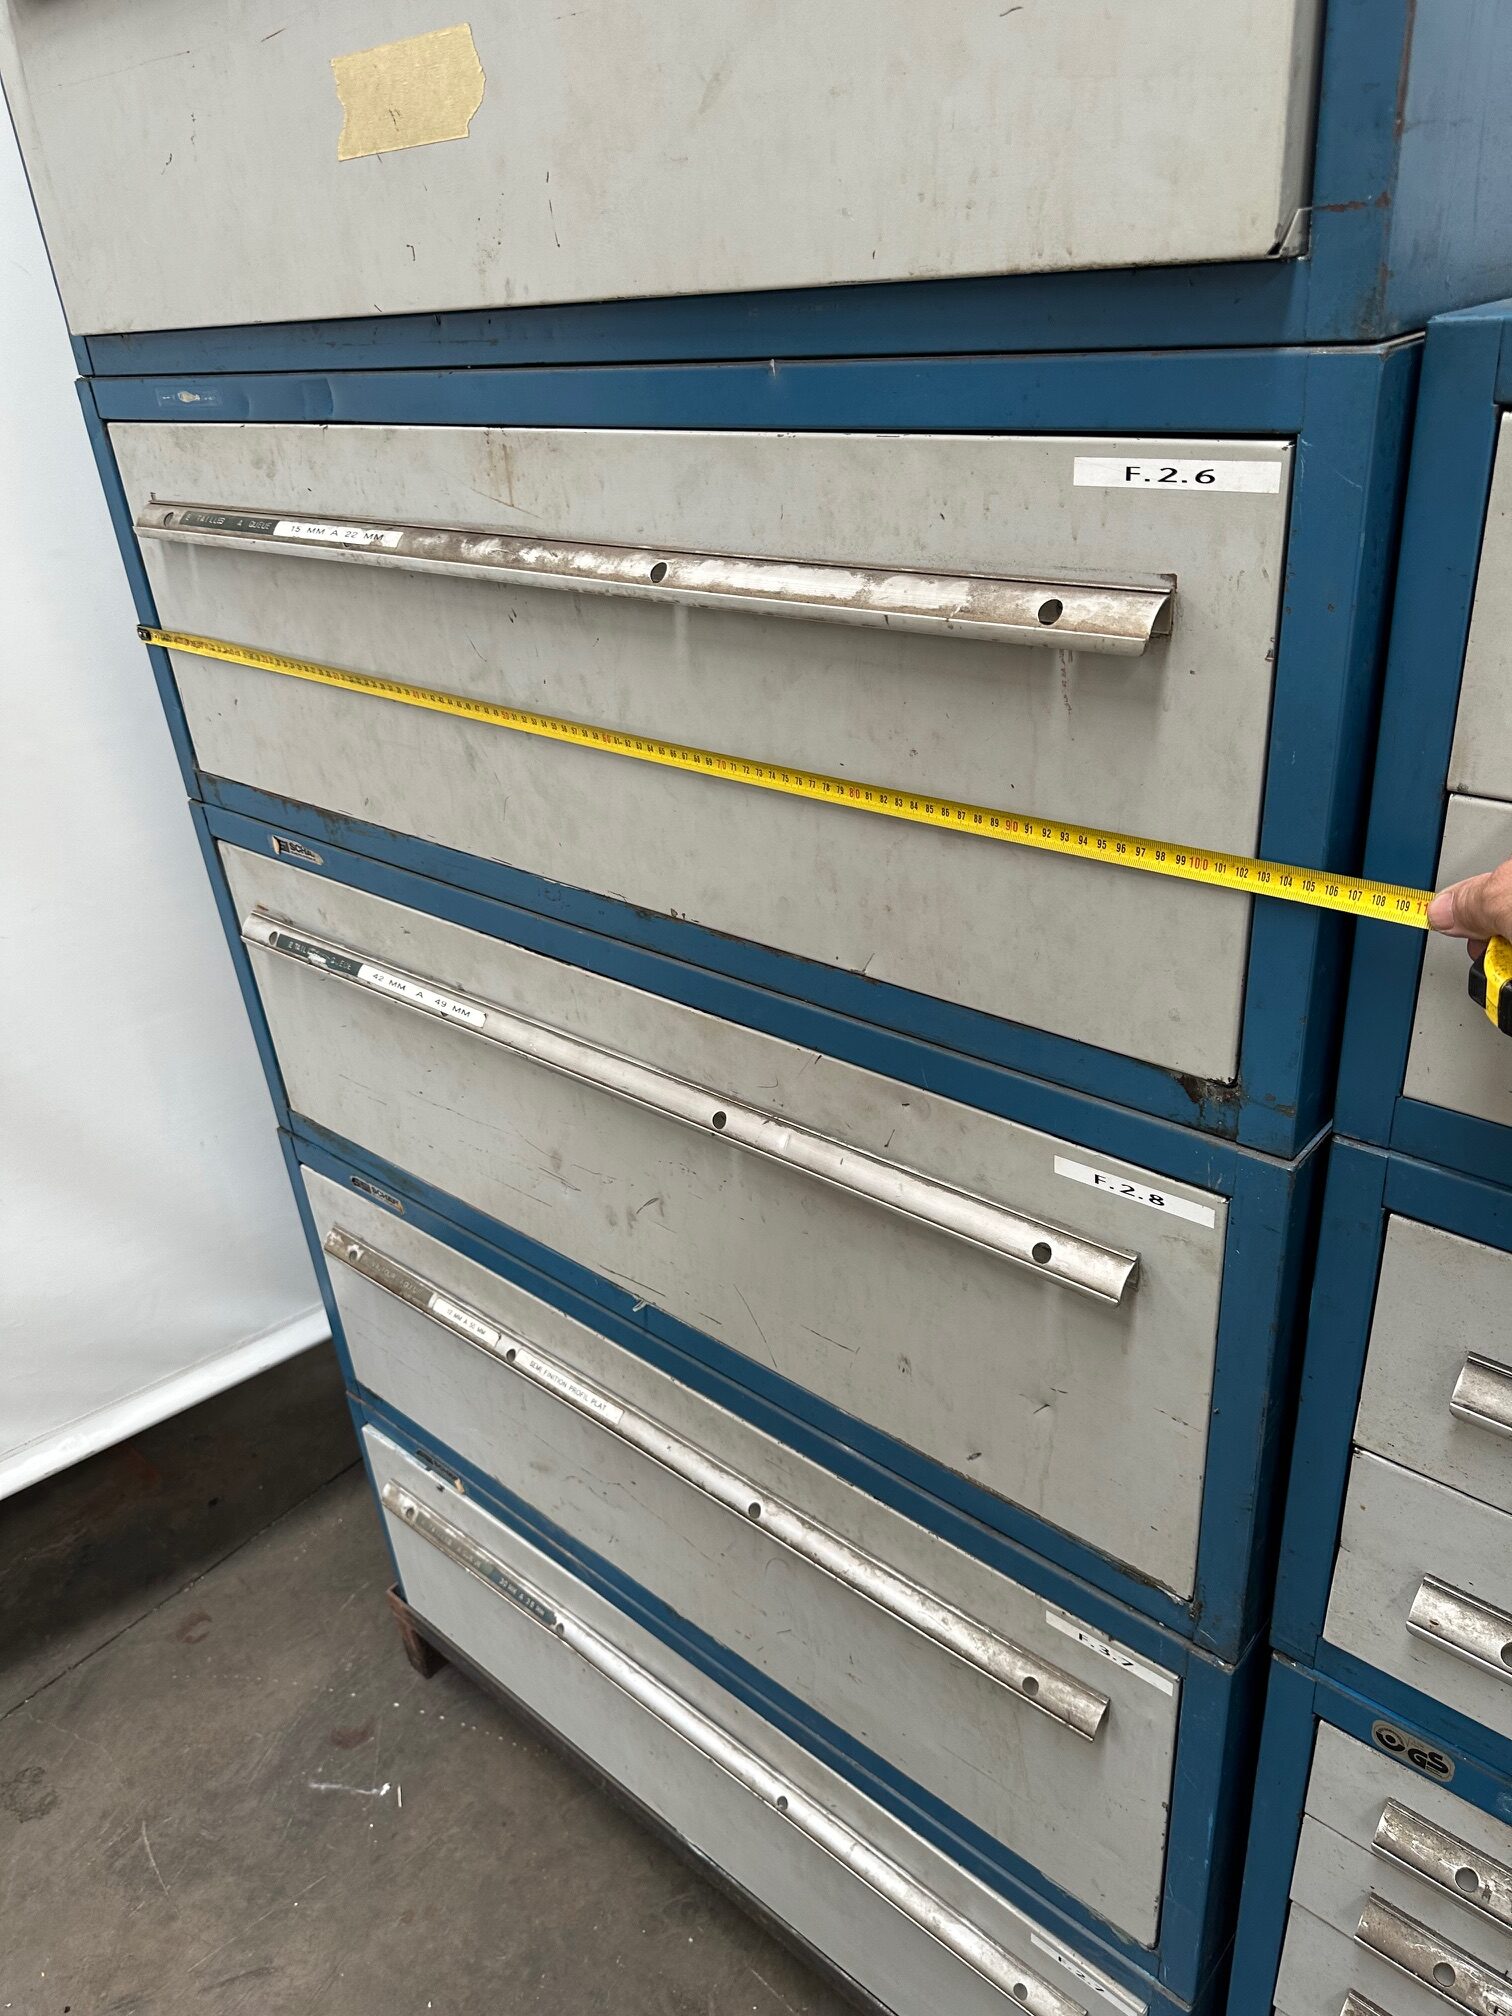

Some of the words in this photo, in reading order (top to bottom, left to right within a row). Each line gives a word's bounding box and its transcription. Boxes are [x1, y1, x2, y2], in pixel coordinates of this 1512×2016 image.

[1125, 466, 1216, 484] F.2.6
[306, 527, 326, 535] MM
[344, 530, 358, 538] 22
[602, 733, 611, 743] 60
[614, 736, 620, 745] 61
[624, 740, 631, 748] 62
[636, 741, 642, 750] 63
[647, 744, 654, 753] 64
[658, 746, 665, 755] 65
[670, 749, 677, 758] 66
[682, 752, 688, 761] 67
[693, 754, 700, 764] 68
[705, 757, 712, 766] 69
[717, 759, 726, 770] 70
[730, 763, 737, 771] 71
[742, 765, 750, 775] 72
[756, 768, 762, 778] 73
[768, 770, 776, 780] 74
[781, 773, 789, 783] 75
[795, 776, 802, 786] 76
[808, 780, 816, 789] 77
[822, 782, 830, 792] 78
[836, 785, 844, 795] 79
[849, 787, 860, 799] 80
[865, 791, 872, 801] 81
[880, 794, 888, 805] 82
[894, 798, 903, 808] 83
[910, 800, 918, 811] 84
[925, 804, 934, 814] 85
[941, 807, 950, 817] 86
[957, 810, 966, 820] 87
[974, 814, 982, 824] 88
[990, 817, 999, 828] 89
[1005, 820, 1018, 833] 90
[1024, 823, 1033, 835] 91
[1042, 828, 1051, 839] 92
[1060, 831, 1070, 842] 93
[1078, 835, 1088, 846] 94
[1097, 839, 1107, 850] 95
[1116, 843, 1126, 854] 96
[1135, 846, 1146, 857] 97
[1155, 850, 1166, 861] 98
[1176, 854, 1186, 866] 99
[1189, 856, 1209, 871] 100
[1214, 862, 1226, 874] 101
[1236, 867, 1248, 879] 102
[1257, 871, 1271, 883] 103
[1280, 875, 1293, 888] 104
[1302, 880, 1316, 892] 105
[1325, 884, 1338, 897] 106
[1348, 889, 1363, 901] 107
[1372, 894, 1386, 906] 108
[1396, 899, 1411, 912] 109
[1416, 901, 1429, 916] 11
[372, 974, 385, 982] 42
[388, 980, 406, 991] MM
[434, 999, 447, 1008] 49
[452, 1005, 471, 1017] MM
[1094, 1174, 1165, 1206] F.2.8
[569, 1385, 588, 1401] PROFIL
[590, 1399, 606, 1411] PLAT
[1079, 1632, 1134, 1666] F.3.7
[1408, 1748, 1449, 1774] GS
